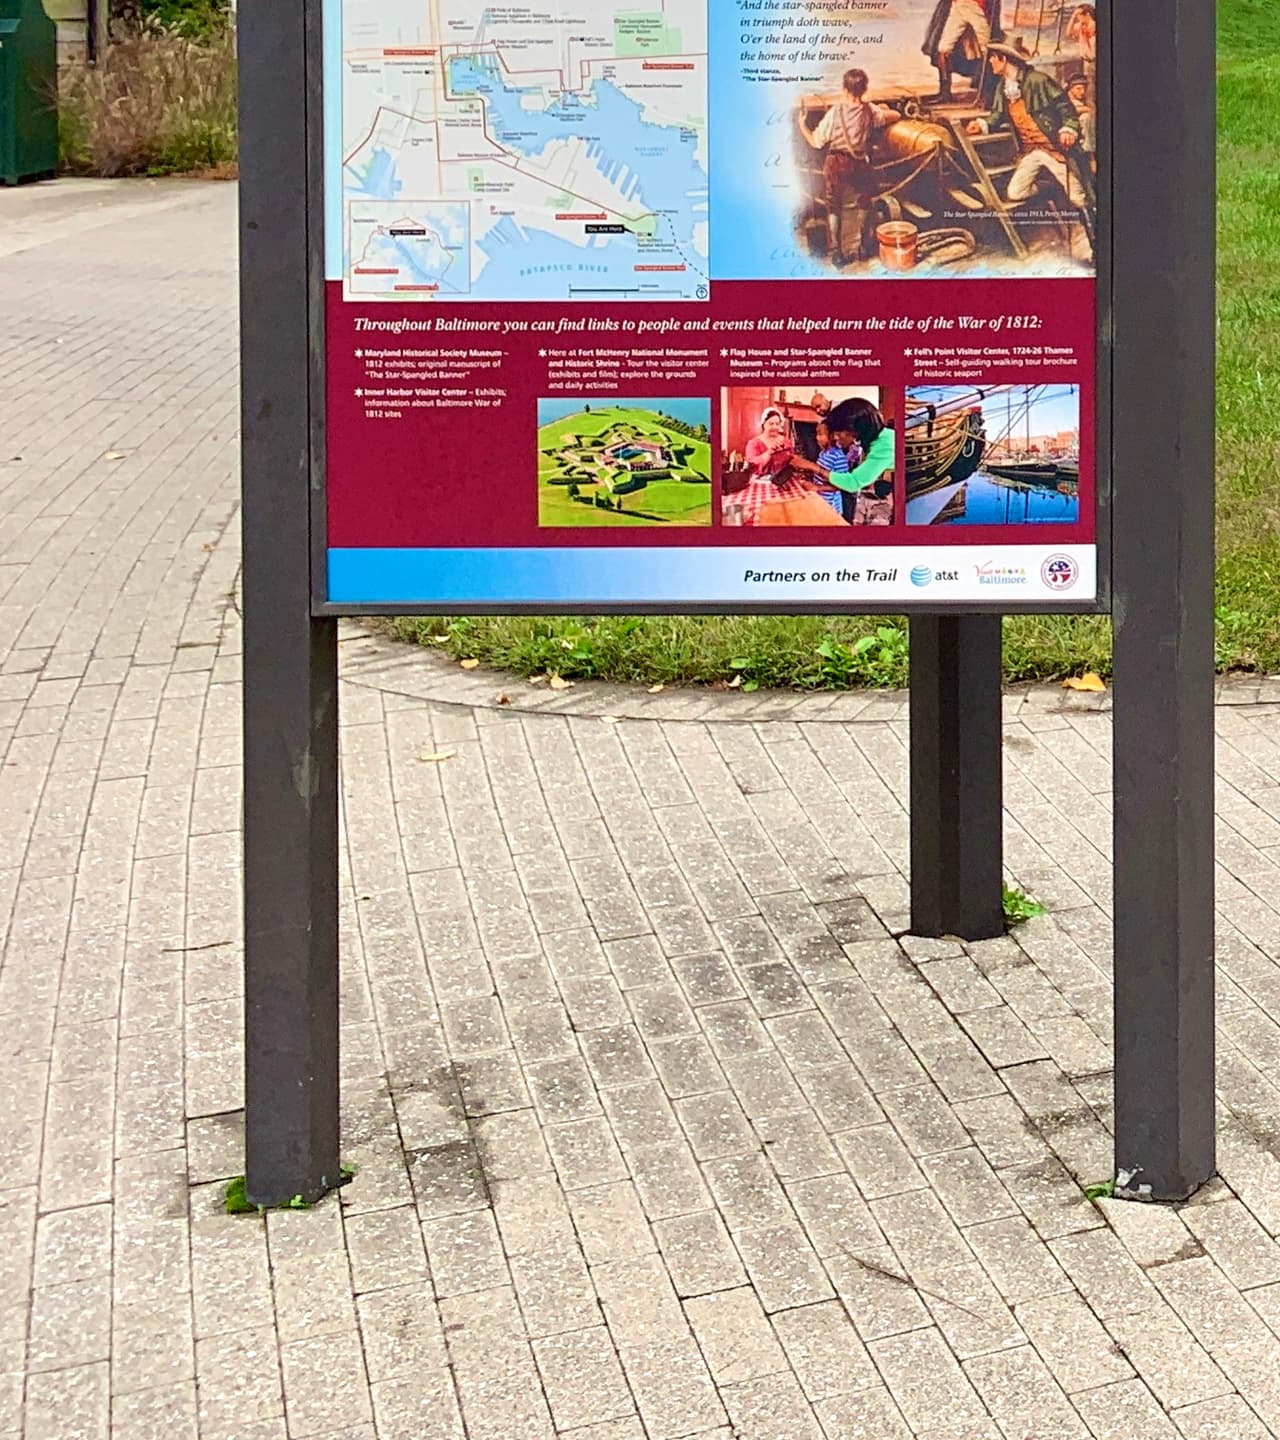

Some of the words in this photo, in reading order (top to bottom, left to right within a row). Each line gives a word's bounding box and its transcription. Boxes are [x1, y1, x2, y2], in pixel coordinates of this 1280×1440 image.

[763, 0, 781, 11] the
[739, 16, 751, 28] in
[752, 16, 795, 30] triumph
[795, 16, 820, 28] doth
[821, 18, 853, 29] wave,
[764, 33, 781, 45] the
[782, 32, 807, 45] land
[807, 32, 820, 48] of
[820, 33, 837, 45] the
[834, 32, 861, 48] free,
[862, 33, 884, 44] and
[739, 50, 757, 62] the
[757, 50, 787, 62] home
[787, 48, 800, 65] of
[800, 50, 817, 62] the
[353, 317, 433, 335] Throughout
[434, 316, 502, 332] Baltimore
[501, 320, 529, 335] you
[530, 320, 556, 332] can
[555, 316, 586, 334] find
[587, 317, 621, 331] links
[621, 319, 636, 331] to
[636, 316, 682, 334] people
[682, 316, 711, 331] and
[711, 319, 755, 331] events
[756, 316, 785, 331] that
[786, 316, 832, 334] helped
[832, 318, 864, 331] turn
[865, 316, 887, 331] the
[888, 316, 916, 330] tide
[916, 315, 933, 333] of
[933, 315, 955, 330] the
[957, 315, 988, 329] War
[988, 314, 1006, 333] of
[1005, 314, 1043, 329] 1812:
[547, 348, 567, 357] Here
[567, 348, 577, 357] at
[577, 348, 595, 357] Fort
[595, 348, 631, 359] McHenry
[631, 348, 665, 357] National
[665, 348, 709, 357] Monument
[729, 347, 747, 359] Flag
[747, 348, 773, 357] House
[773, 347, 789, 357] and
[789, 347, 844, 358] Star-Spangled
[844, 347, 873, 356] Banner
[729, 369, 761, 380] inspired
[761, 369, 776, 378] the
[776, 369, 809, 378] national
[809, 369, 840, 378] anthem
[743, 569, 807, 583] Partners
[810, 571, 831, 583] on
[835, 568, 861, 583] the
[865, 568, 898, 582] Trail
[934, 570, 959, 581] at&t
